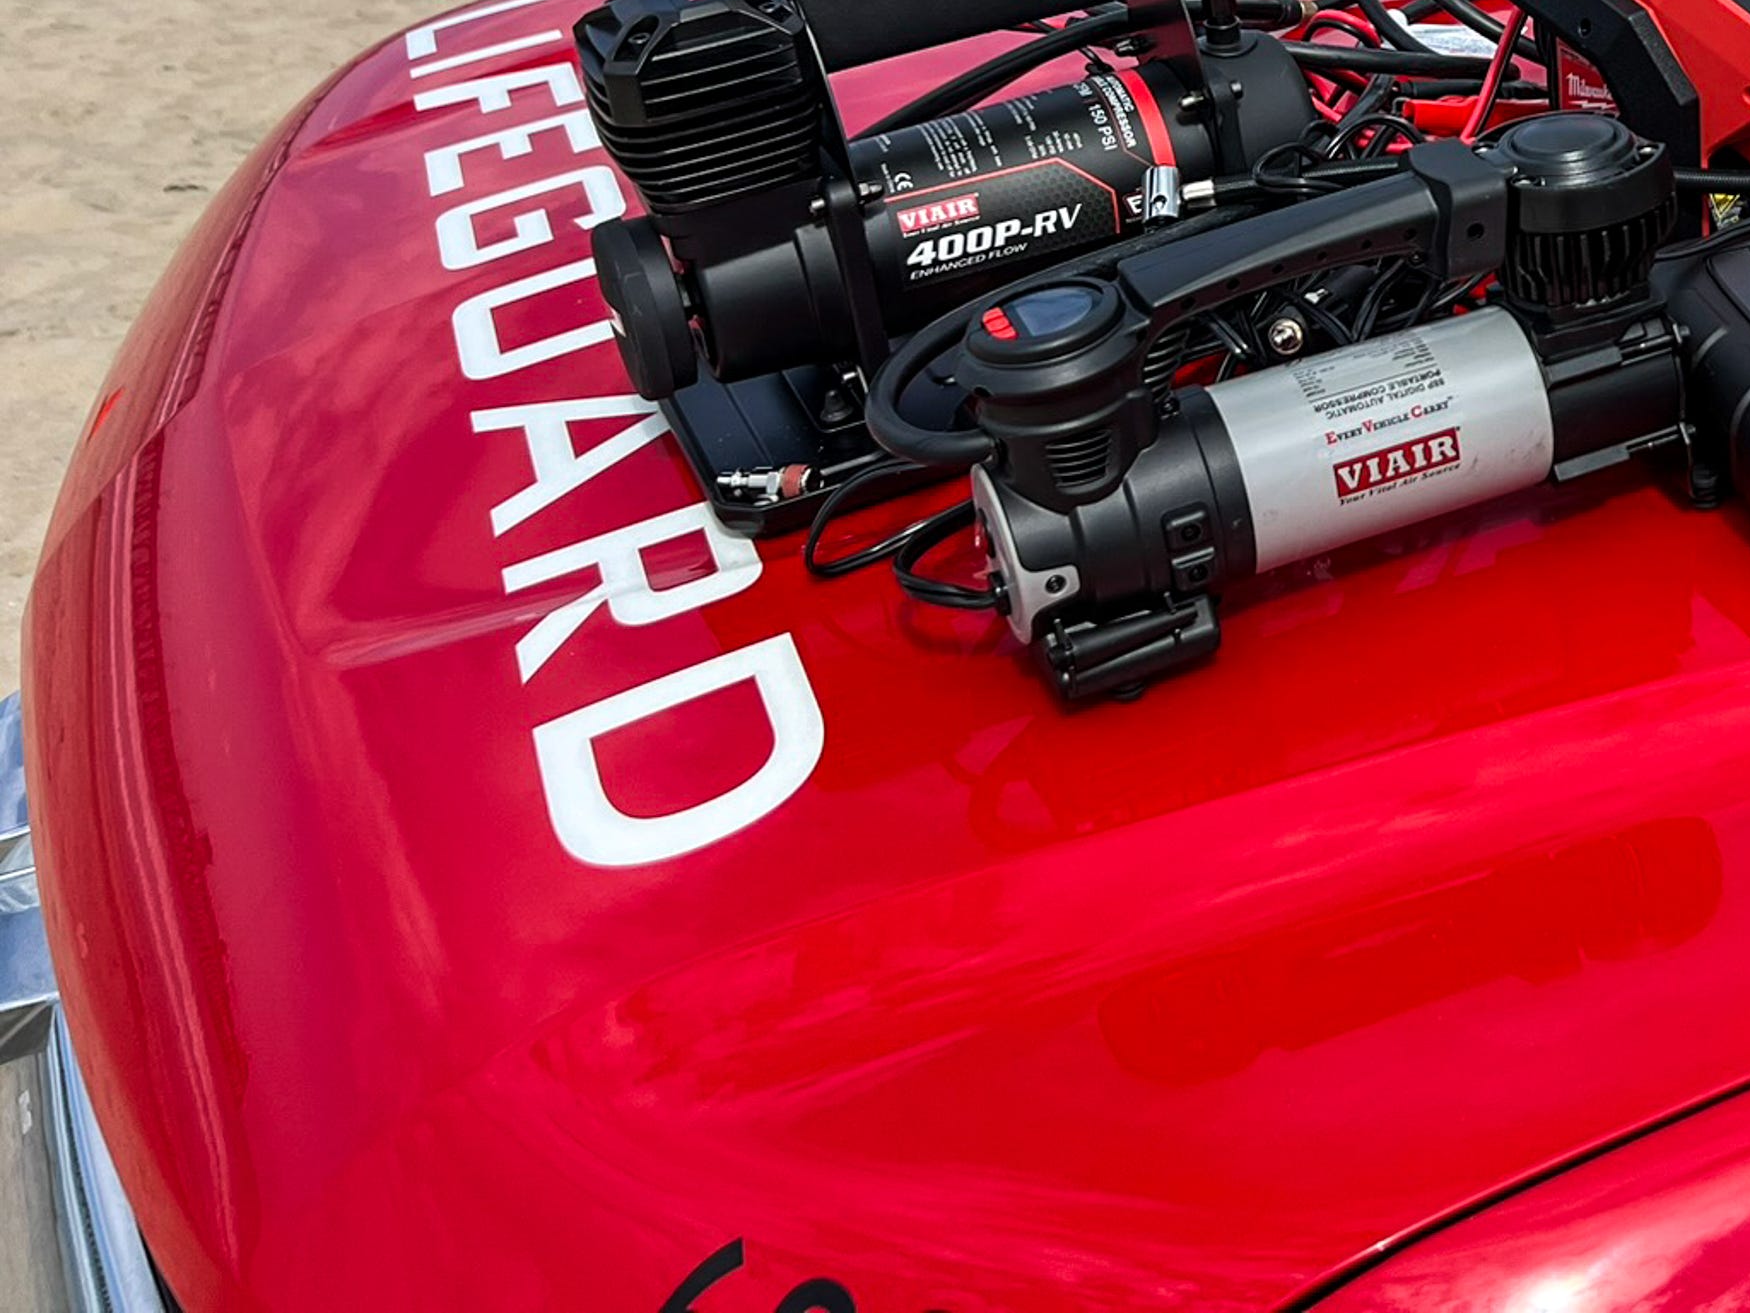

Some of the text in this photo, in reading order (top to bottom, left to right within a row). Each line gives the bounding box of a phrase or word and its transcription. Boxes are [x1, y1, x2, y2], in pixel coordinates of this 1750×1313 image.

[1088, 104, 1108, 125] 150
[1098, 126, 1118, 151] PSI
[1102, 87, 1137, 148] COMPRESSOR
[899, 195, 979, 230] VIAIR
[906, 203, 1082, 267] 400P-RV
[910, 242, 1028, 280] ENHANCED FLOW
[1314, 368, 1441, 413] PORTABLE COMPRESSOR
[1326, 395, 1385, 420] AUTOMATIC
[1388, 382, 1426, 401] DIGITAL
[1336, 434, 1458, 490] VIAIR
[1399, 476, 1417, 487] Air
[1421, 464, 1460, 480] Source
